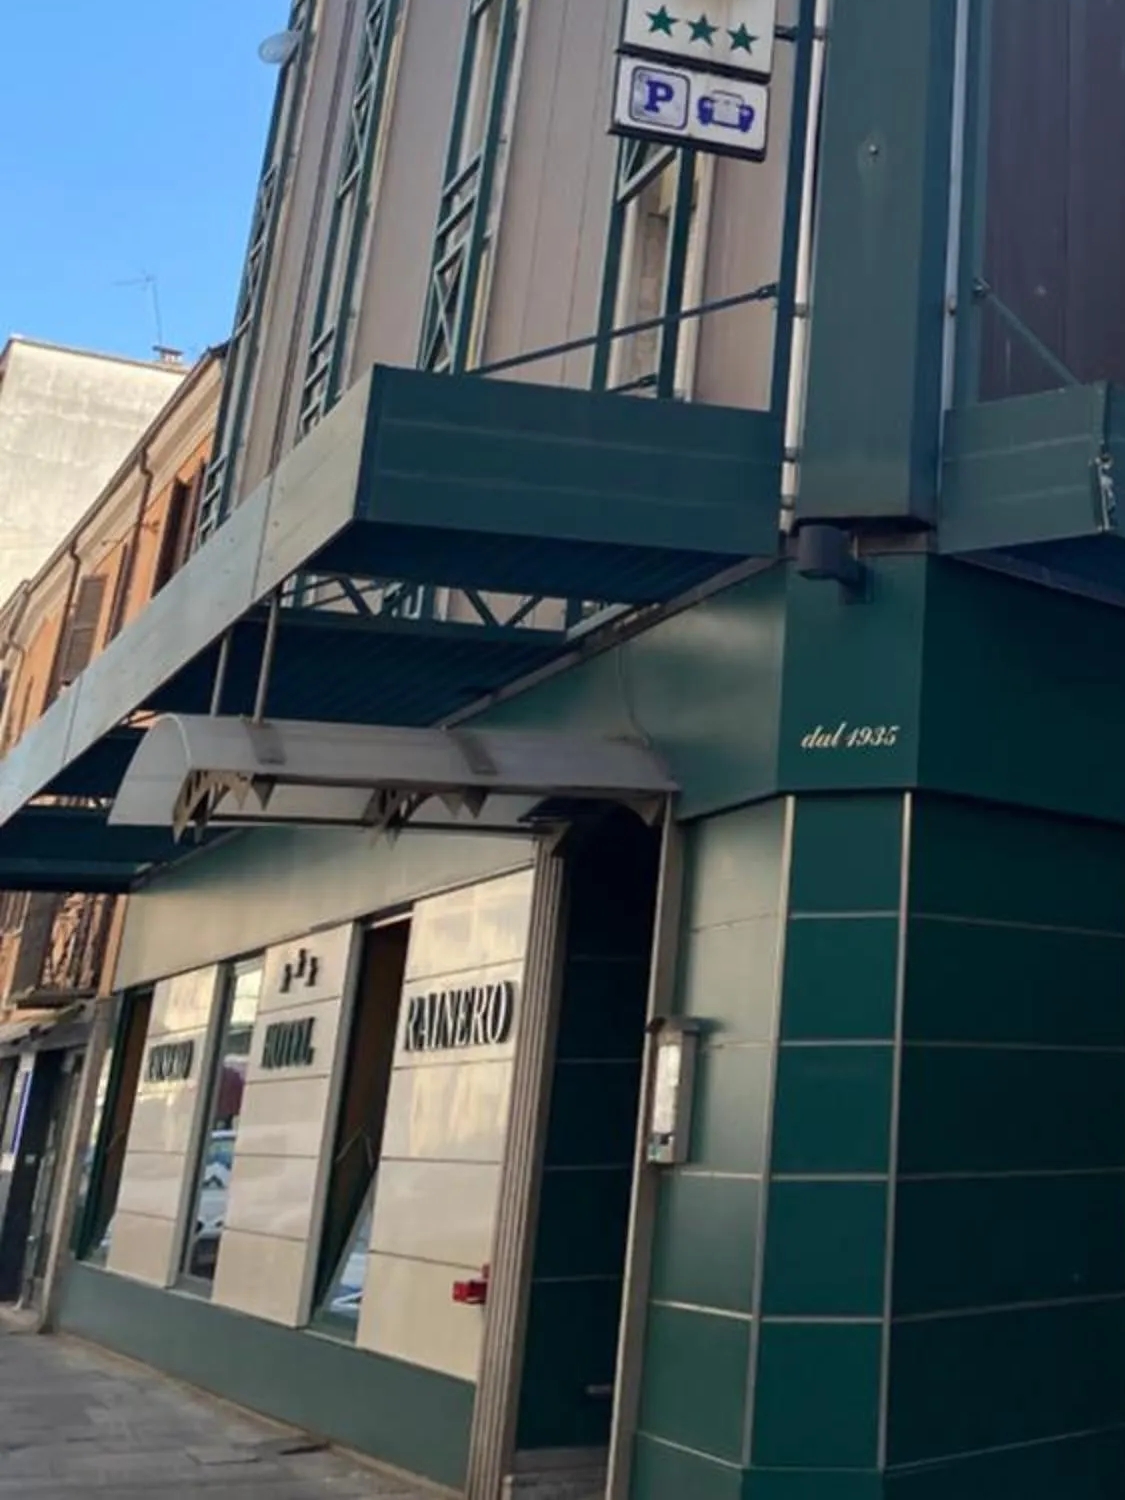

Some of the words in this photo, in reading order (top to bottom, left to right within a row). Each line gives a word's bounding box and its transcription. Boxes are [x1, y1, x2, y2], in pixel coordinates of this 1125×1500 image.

[644, 79, 674, 113] P
[801, 721, 847, 749] dal
[847, 725, 900, 747] 1935
[404, 980, 515, 1053] RAINERO
